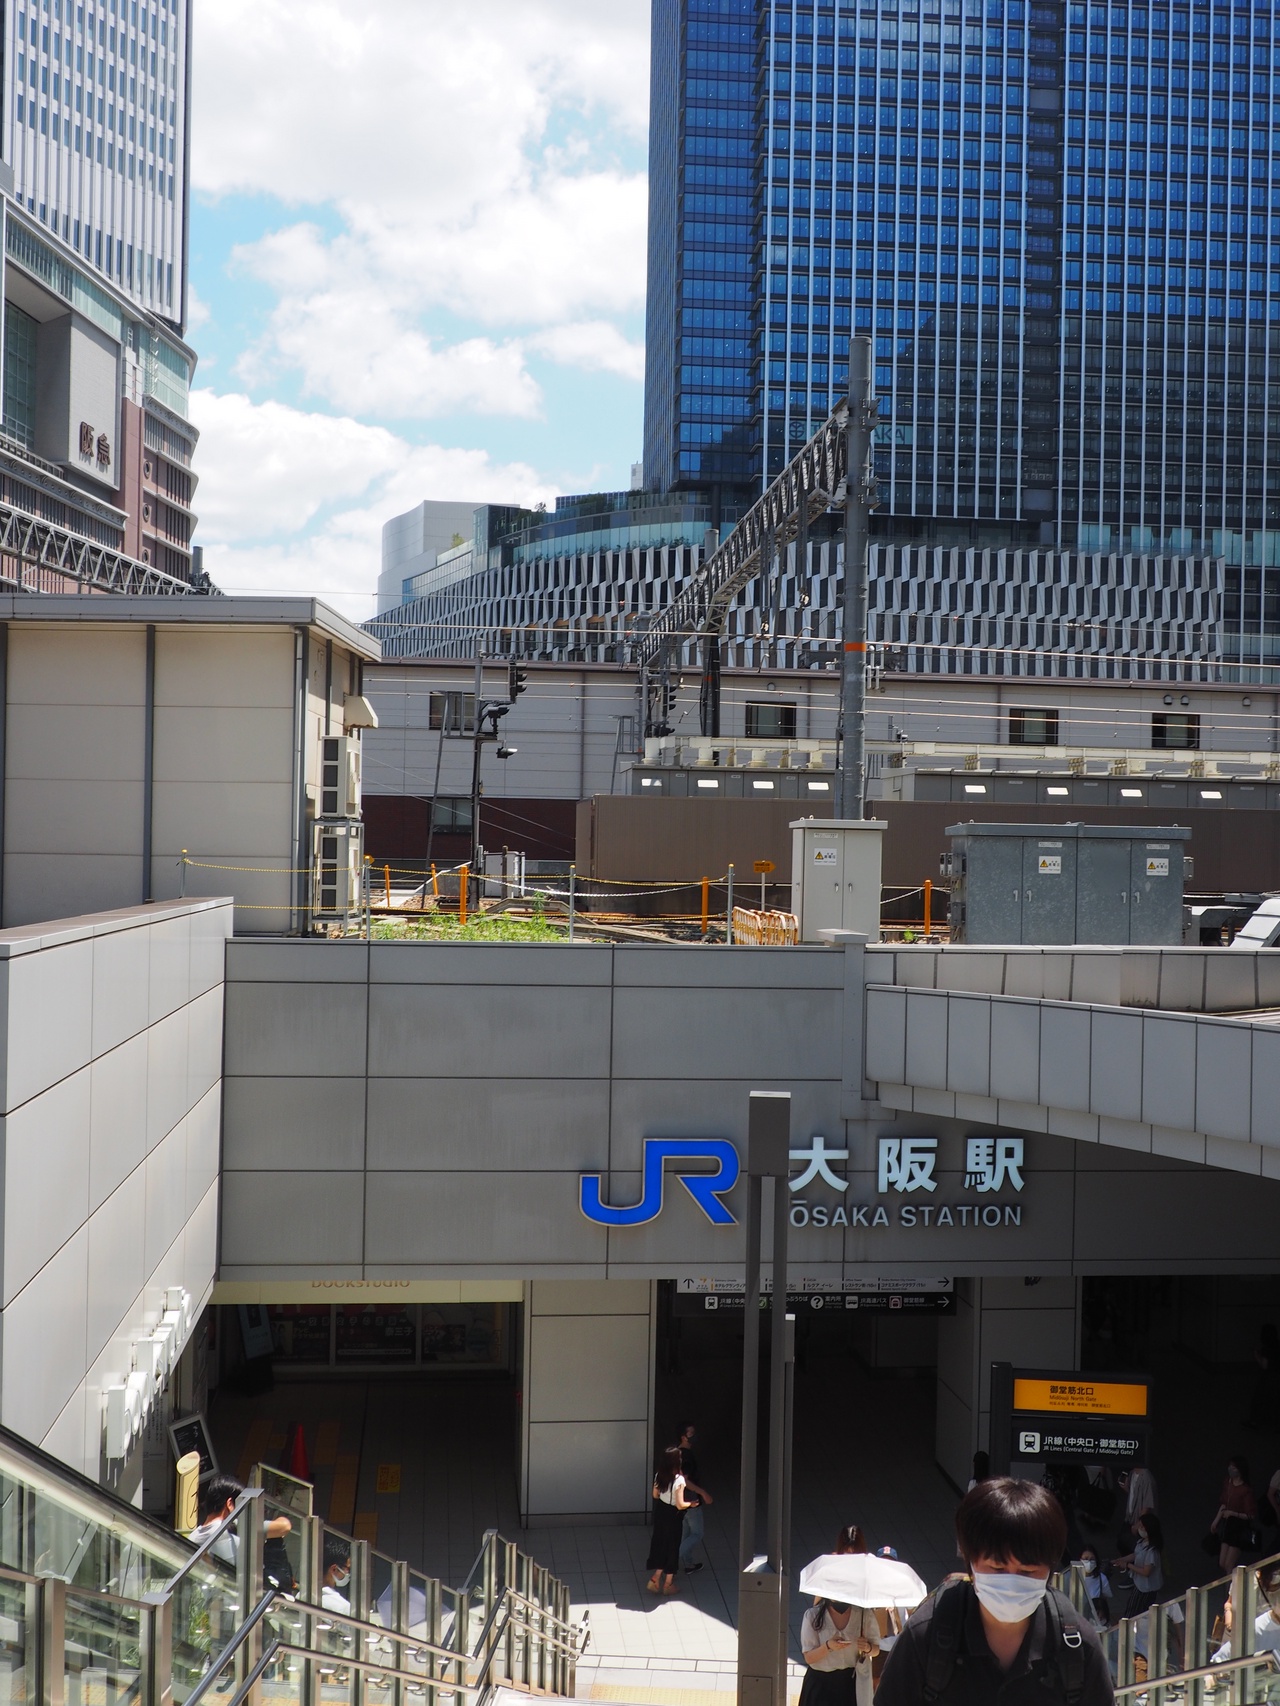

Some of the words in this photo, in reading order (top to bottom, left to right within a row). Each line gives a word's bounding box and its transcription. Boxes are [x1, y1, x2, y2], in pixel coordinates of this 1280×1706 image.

[80, 421, 111, 465] 阪急
[579, 1138, 740, 1227] JR
[788, 1136, 1025, 1193] 大阪駅
[900, 1205, 1022, 1227] STATION
[1049, 1385, 1094, 1395] 御堂筋北口
